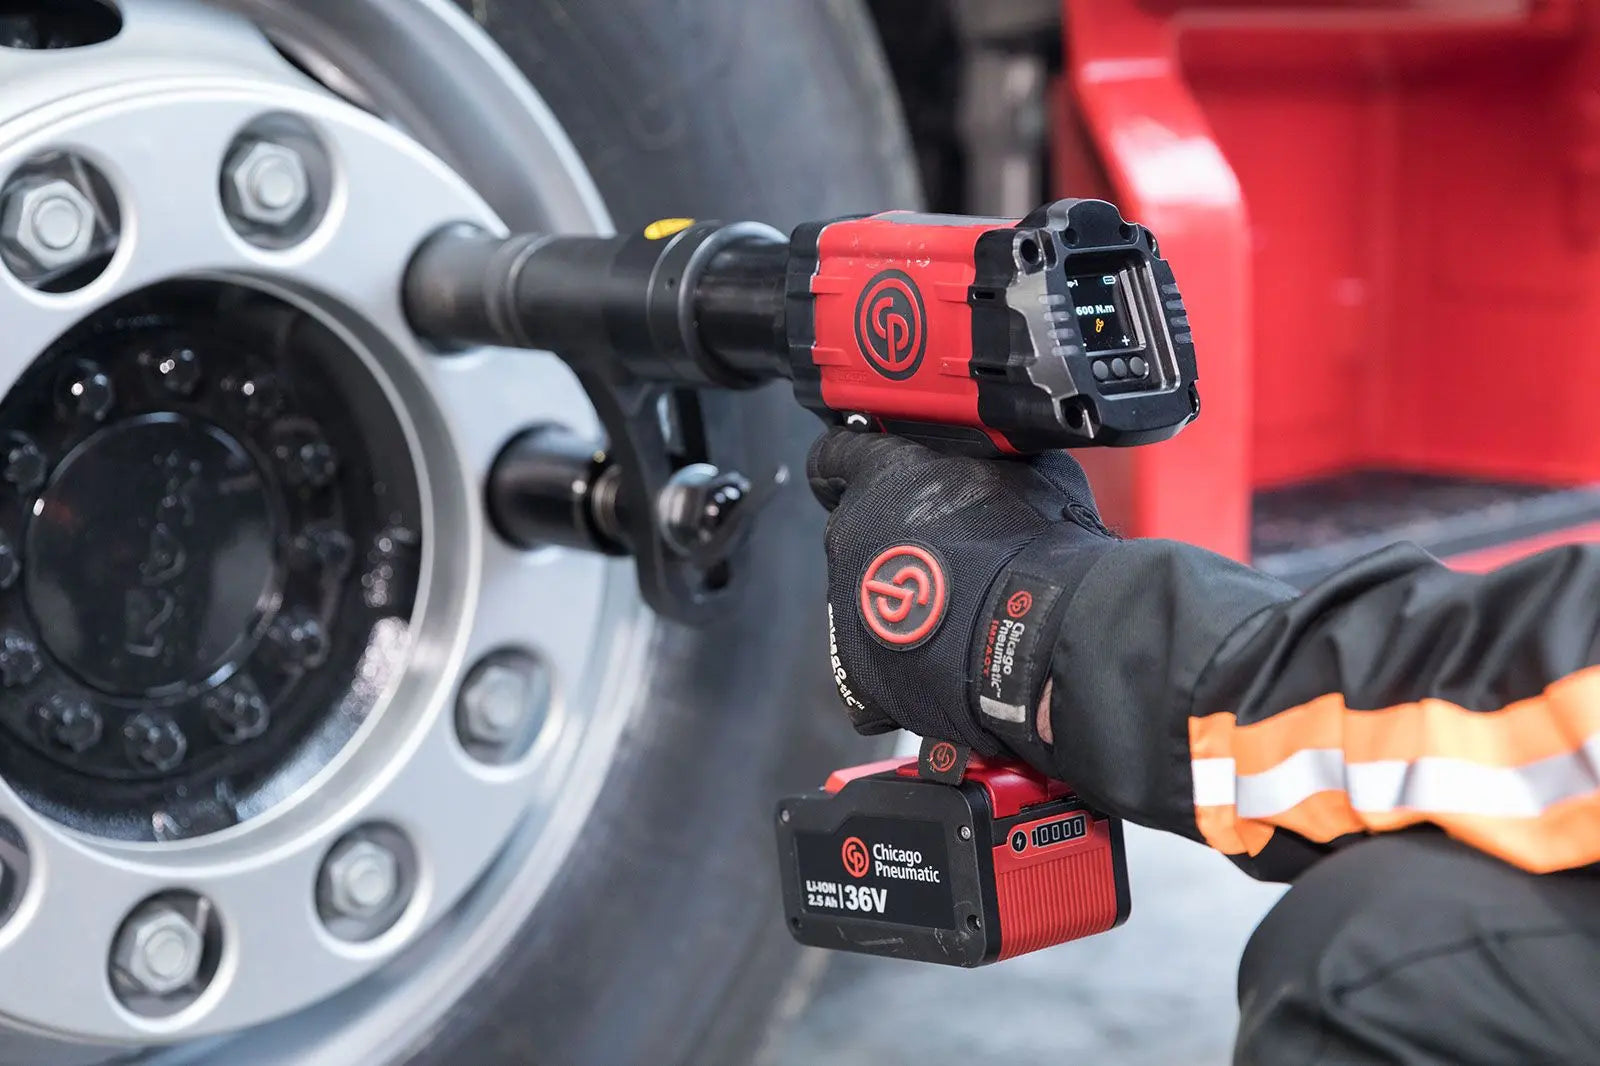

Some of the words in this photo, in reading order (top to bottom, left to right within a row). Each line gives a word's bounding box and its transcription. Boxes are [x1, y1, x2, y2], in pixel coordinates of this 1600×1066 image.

[1075, 305, 1092, 316] 600
[1095, 304, 1115, 314] N.m
[983, 619, 1000, 678] IMPACT
[1003, 621, 1025, 675] Chicago
[872, 843, 922, 867] Chicago
[874, 861, 941, 884] Pneumatic
[805, 880, 837, 894] LI-ION
[808, 894, 824, 907] 2.5
[824, 896, 838, 908] Ah
[844, 884, 888, 914] 36V
